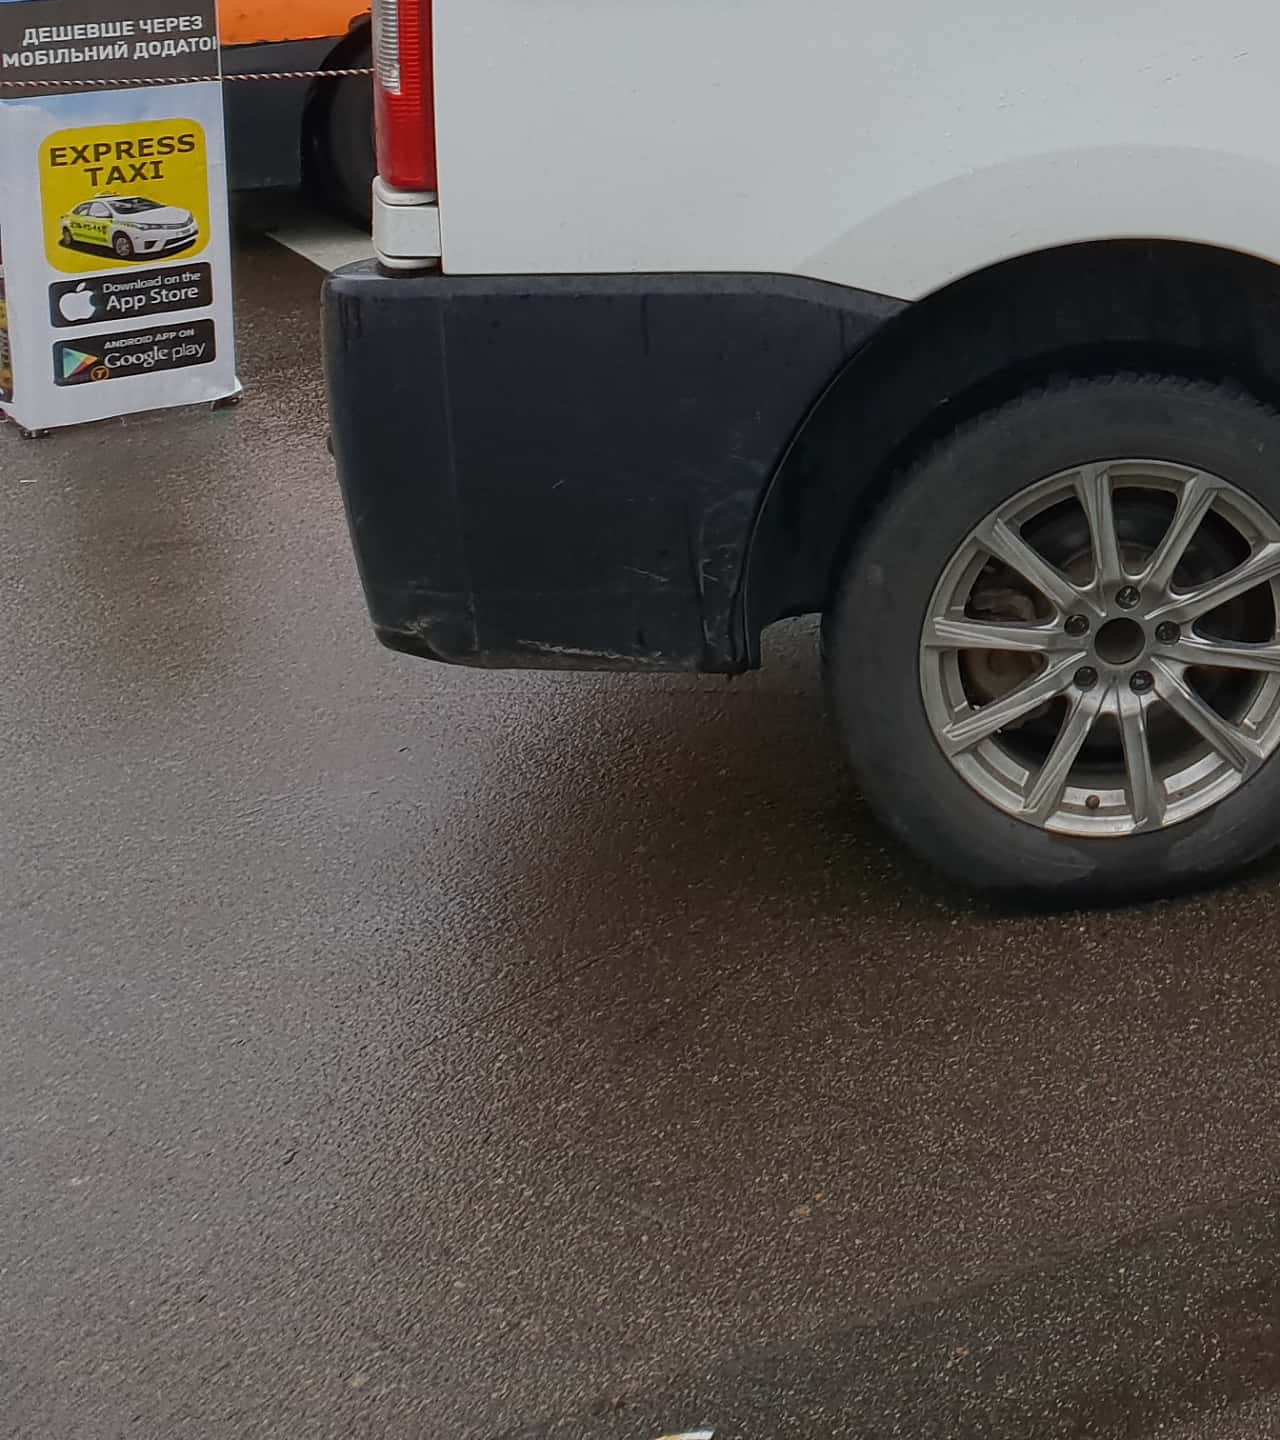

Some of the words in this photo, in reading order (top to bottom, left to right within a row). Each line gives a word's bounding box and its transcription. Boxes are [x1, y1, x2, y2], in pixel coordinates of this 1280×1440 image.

[22, 20, 136, 46] ДЕШЕВШЕ
[139, 15, 203, 34] ЧЕРЕЗ
[2, 40, 129, 68] МОБІЛЬНИЙ
[50, 134, 196, 167] EXPRESS
[83, 160, 164, 186] TAXI
[102, 276, 162, 293] Download
[164, 276, 180, 285] on
[182, 271, 201, 282] the
[106, 293, 146, 312] App
[150, 286, 199, 304] Store
[104, 335, 153, 349] ANDROID
[155, 331, 176, 342] APP
[178, 328, 195, 338] ON
[104, 345, 169, 368] Google
[172, 342, 206, 359] play
